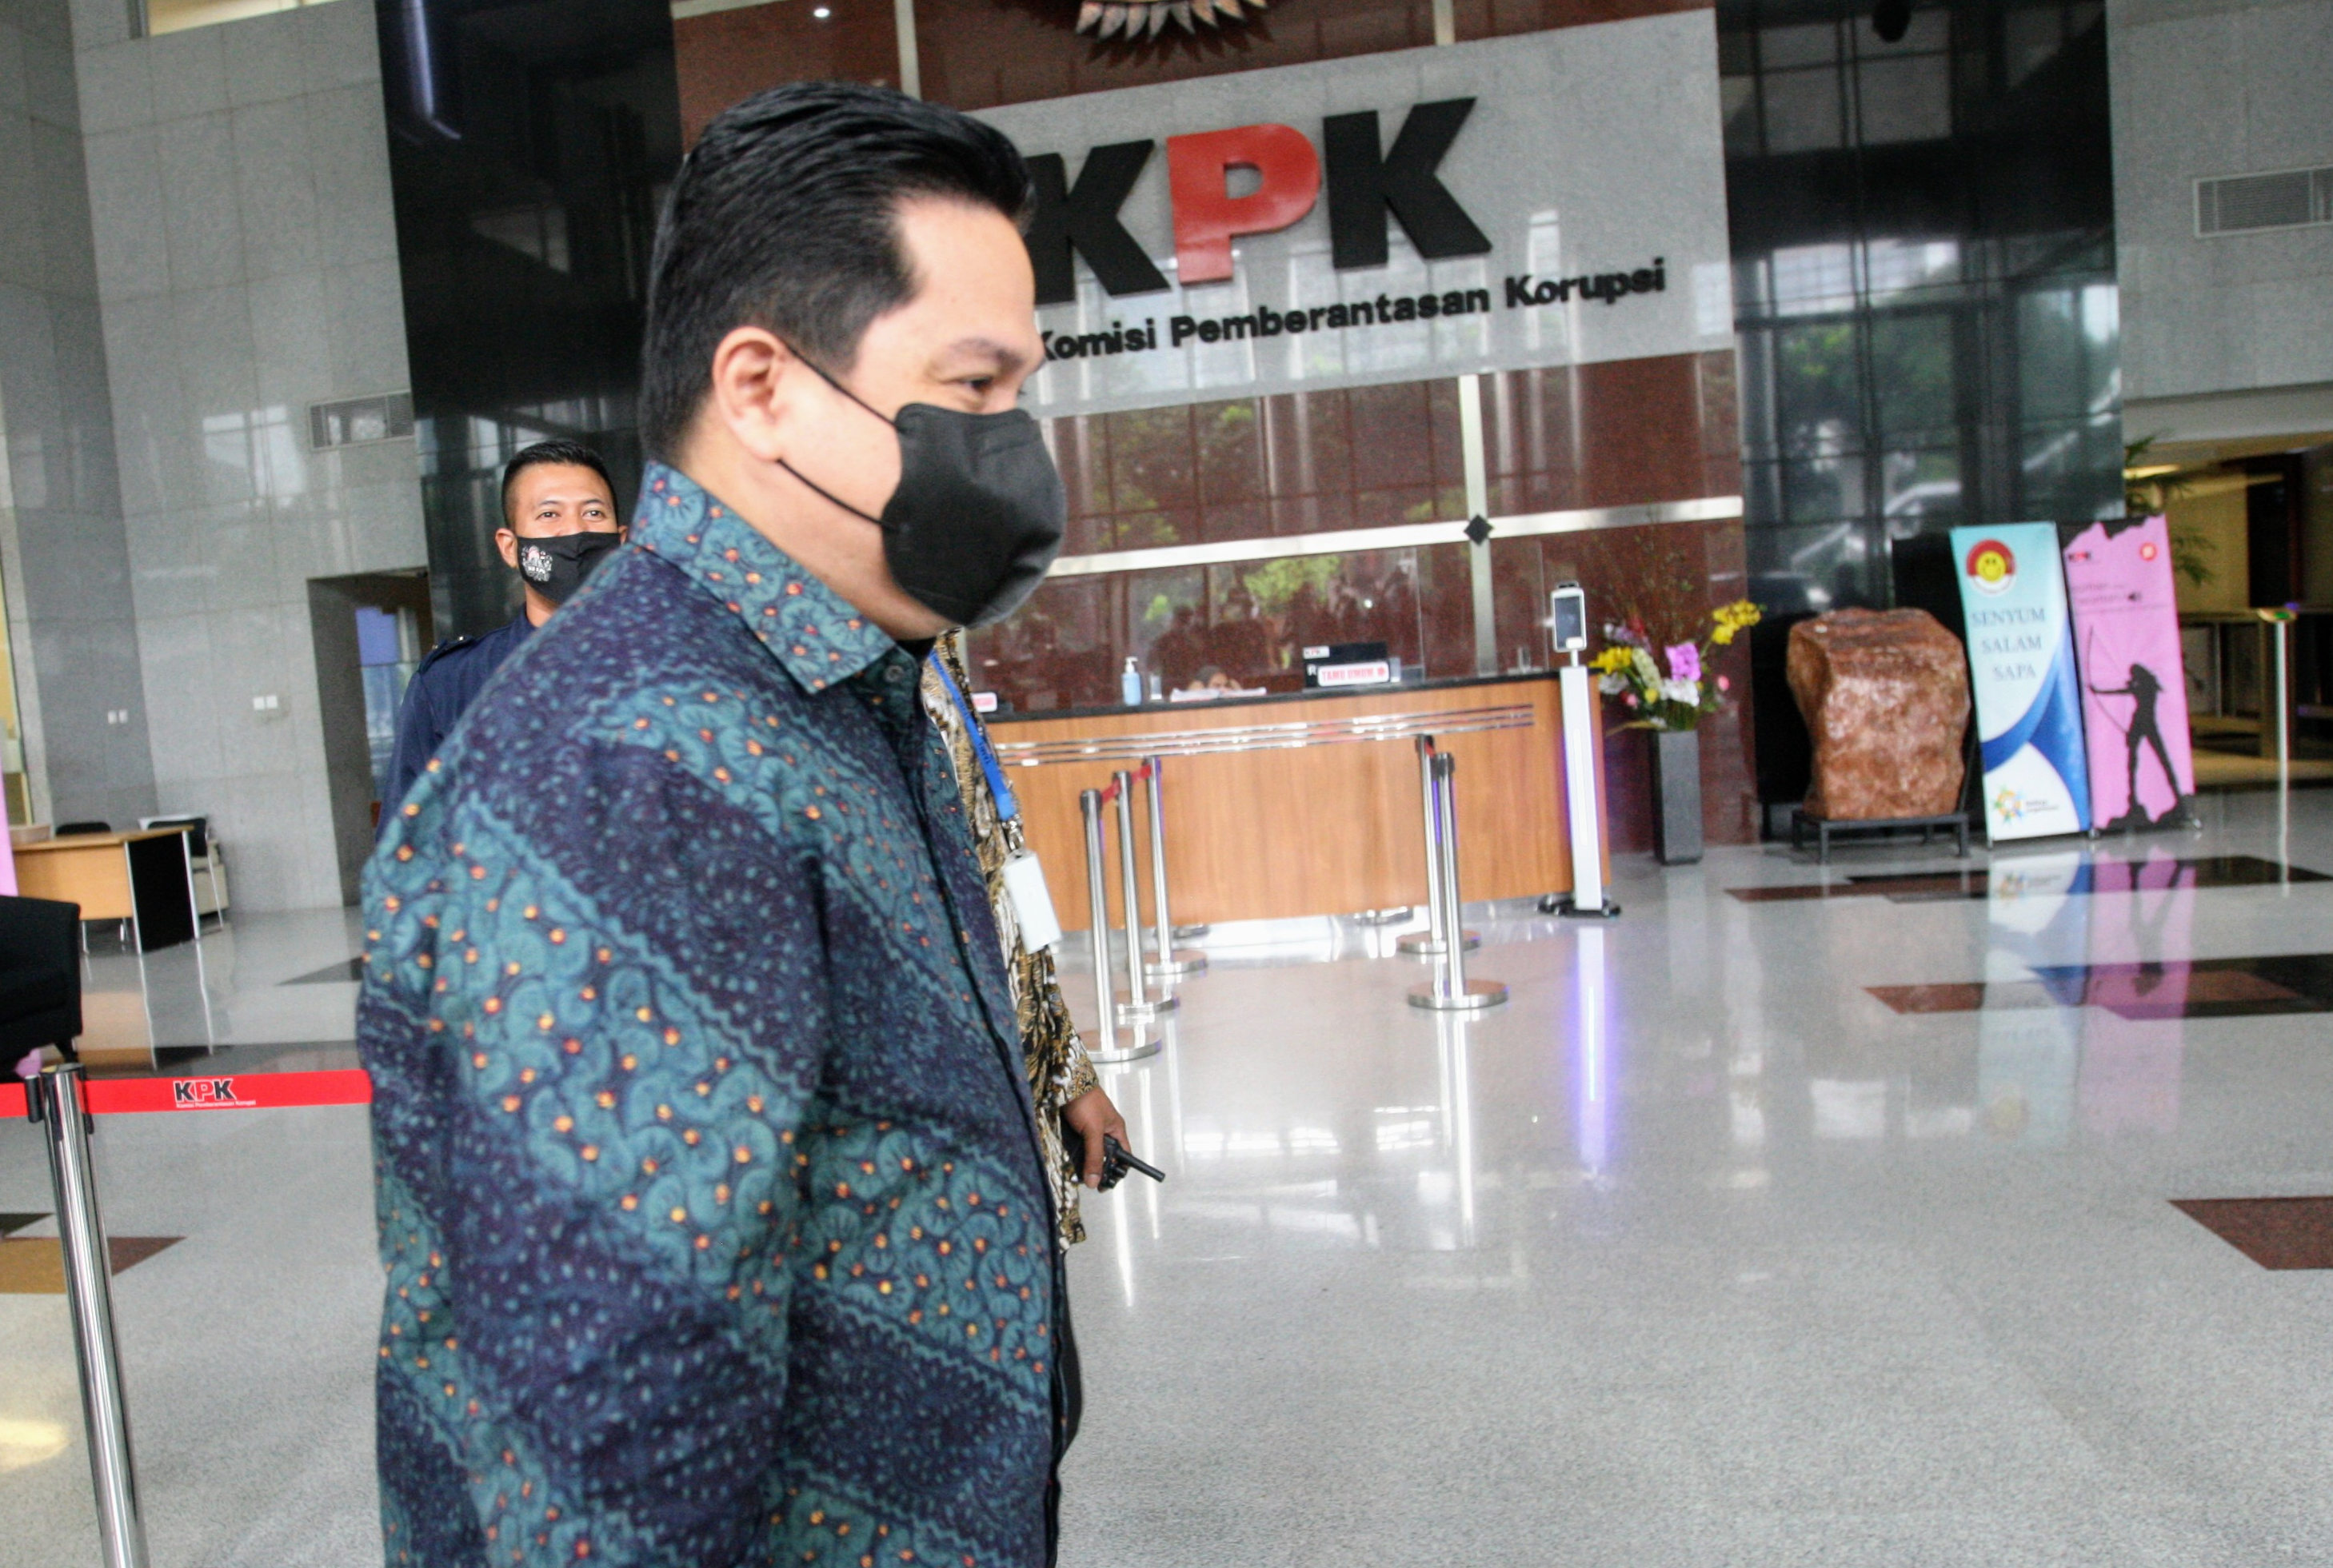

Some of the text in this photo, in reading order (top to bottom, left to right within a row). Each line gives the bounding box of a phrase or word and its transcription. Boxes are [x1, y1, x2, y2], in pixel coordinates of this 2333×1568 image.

[1024, 97, 1493, 304] KPK
[1169, 286, 1491, 348] Pemberantasan
[1504, 256, 1666, 309] Korupsi
[1971, 607, 2046, 627] SENYUM
[1981, 636, 2043, 654] SALAM
[1992, 663, 2037, 680] SAPA
[173, 1078, 238, 1102] KPK
